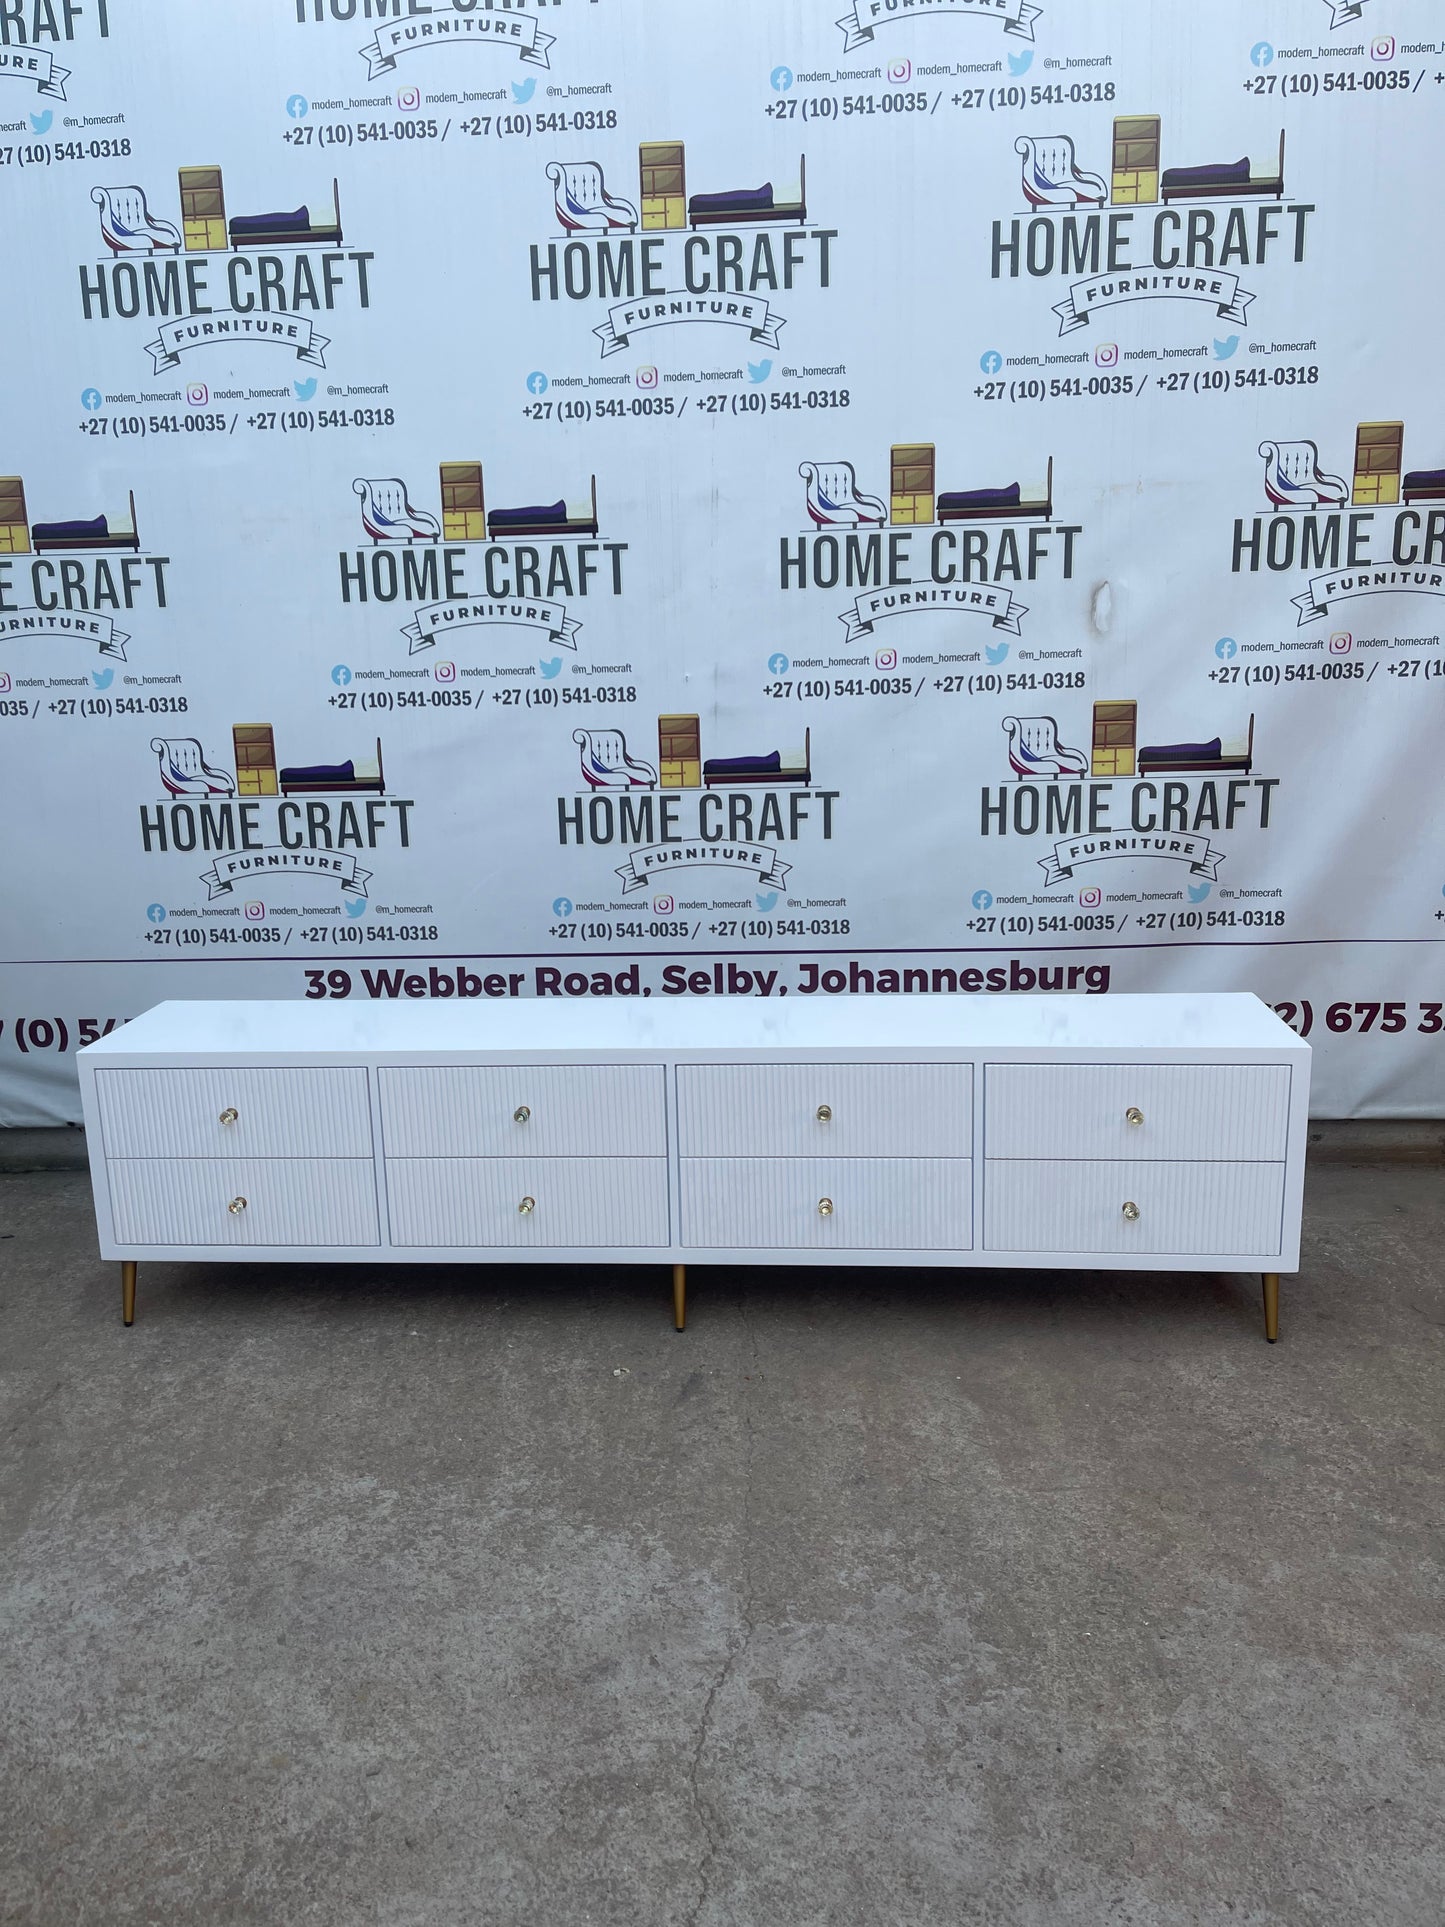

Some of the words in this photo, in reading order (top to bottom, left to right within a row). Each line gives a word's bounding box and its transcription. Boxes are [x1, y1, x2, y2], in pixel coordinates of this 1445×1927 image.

[391, 18, 522, 44] FURNITURE
[1044, 55, 1112, 70] @m_homecraft
[546, 83, 612, 98] @m_homecraft
[1243, 76, 1277, 94] +27
[1282, 74, 1318, 97] (10)
[1323, 70, 1410, 91] 541-0035
[765, 100, 797, 119] +27
[802, 97, 838, 122] (10)
[843, 92, 927, 115] 541-0035
[951, 89, 984, 108] +27
[989, 87, 1025, 111] (10)
[1031, 82, 1115, 104] 541-0318
[283, 127, 313, 145] +27
[319, 124, 353, 148] (10)
[358, 120, 437, 141] 541-0035
[460, 117, 491, 135] +27
[497, 115, 531, 138] (10)
[536, 110, 617, 132] 541-0318
[18, 144, 51, 167] (10)
[55, 138, 131, 160] 541-0318
[992, 213, 1133, 278] HOME
[1153, 205, 1315, 269] CRAFT
[530, 239, 665, 301] HOME
[685, 231, 838, 294] CRAFT
[79, 259, 212, 319] HOME
[228, 252, 374, 313] CRAFT
[1087, 277, 1222, 299] FURNITURE
[625, 301, 753, 324] FURNITURE
[174, 320, 297, 341] FURNITURE
[1249, 340, 1316, 354] @m_homecraft
[782, 364, 846, 378] @m_homecraft
[327, 385, 389, 397] @m_homecraft
[974, 382, 1006, 400] +27
[1010, 380, 1045, 402] (10)
[1050, 376, 1133, 397] 541-0035
[1157, 373, 1189, 391] +27
[1194, 371, 1230, 393] (10)
[1235, 366, 1318, 387] 541-0318
[523, 402, 553, 419] +27
[558, 401, 591, 422] (10)
[596, 398, 674, 417] 541-0035
[697, 395, 727, 412] +27
[732, 394, 766, 415] (10)
[770, 390, 850, 410] 541-0318
[79, 418, 108, 435] +27
[113, 417, 145, 438] (10)
[150, 414, 226, 433] 541-0035
[247, 413, 276, 429] +27
[281, 411, 314, 432] (10)
[319, 408, 394, 427] 541-0318
[1232, 513, 1374, 572] HOME
[781, 533, 912, 589] HOME
[931, 526, 1082, 584] CRAFT
[31, 557, 170, 611] CRAFT
[340, 549, 468, 602] HOME
[485, 544, 628, 598] CRAFT
[871, 590, 996, 612] FURNITURE
[430, 605, 551, 624] FURNITURE
[1019, 648, 1083, 664] @m_homecraft
[572, 663, 632, 675] @m_homecraft
[1209, 667, 1240, 683] +27
[1245, 665, 1280, 686] (10)
[1285, 662, 1364, 681] 541-0035
[1388, 660, 1420, 677] +27
[763, 682, 793, 698] +27
[797, 681, 830, 701] (10)
[835, 678, 911, 696] 541-0035
[934, 676, 964, 692] +27
[968, 675, 1002, 695] (10)
[1007, 672, 1085, 690] 541-0318
[49, 699, 76, 714] +27
[81, 699, 112, 718] (10)
[116, 697, 188, 713] 541-0318
[328, 693, 356, 708] +27
[362, 692, 393, 711] (10)
[398, 690, 471, 707] 541-0035
[493, 689, 521, 705] +27
[526, 689, 558, 708] (10)
[563, 687, 636, 703] 541-0318
[558, 795, 682, 844] HOME
[700, 792, 839, 842] CRAFT
[981, 784, 1112, 835] HOME
[1132, 779, 1280, 832] CRAFT
[140, 803, 263, 851] HOME
[278, 800, 414, 849] CRAFT
[644, 848, 761, 866] FURNITURE
[1070, 839, 1194, 857] FURNITURE
[228, 855, 342, 873] FURNITURE
[787, 898, 847, 909] @m_homecraft
[1219, 889, 1282, 900] @m_homecraft
[375, 904, 434, 915] @m_homecraft
[549, 924, 577, 938] +27
[581, 923, 612, 941] (10)
[616, 922, 688, 937] 541-0035
[709, 921, 737, 936] +27
[741, 921, 772, 939] (10)
[777, 919, 850, 935] 541-0318
[967, 917, 996, 932] +27
[1001, 917, 1033, 935] (10)
[1038, 915, 1114, 931] 541-0035
[1136, 913, 1166, 928] +27
[1170, 912, 1202, 931] (10)
[1207, 911, 1285, 926] 541-0318
[145, 930, 171, 943] +27
[176, 929, 206, 946] (10)
[210, 928, 280, 943] 541-0035
[300, 927, 328, 941] +27
[332, 927, 363, 944] (10)
[367, 926, 438, 941] 541-0318
[304, 968, 352, 999] 39
[360, 966, 525, 998] Webber
[535, 964, 652, 997] Road,
[661, 962, 788, 997] Selby,
[796, 959, 1111, 995] Johannesburg
[1325, 1002, 1407, 1033] 675
